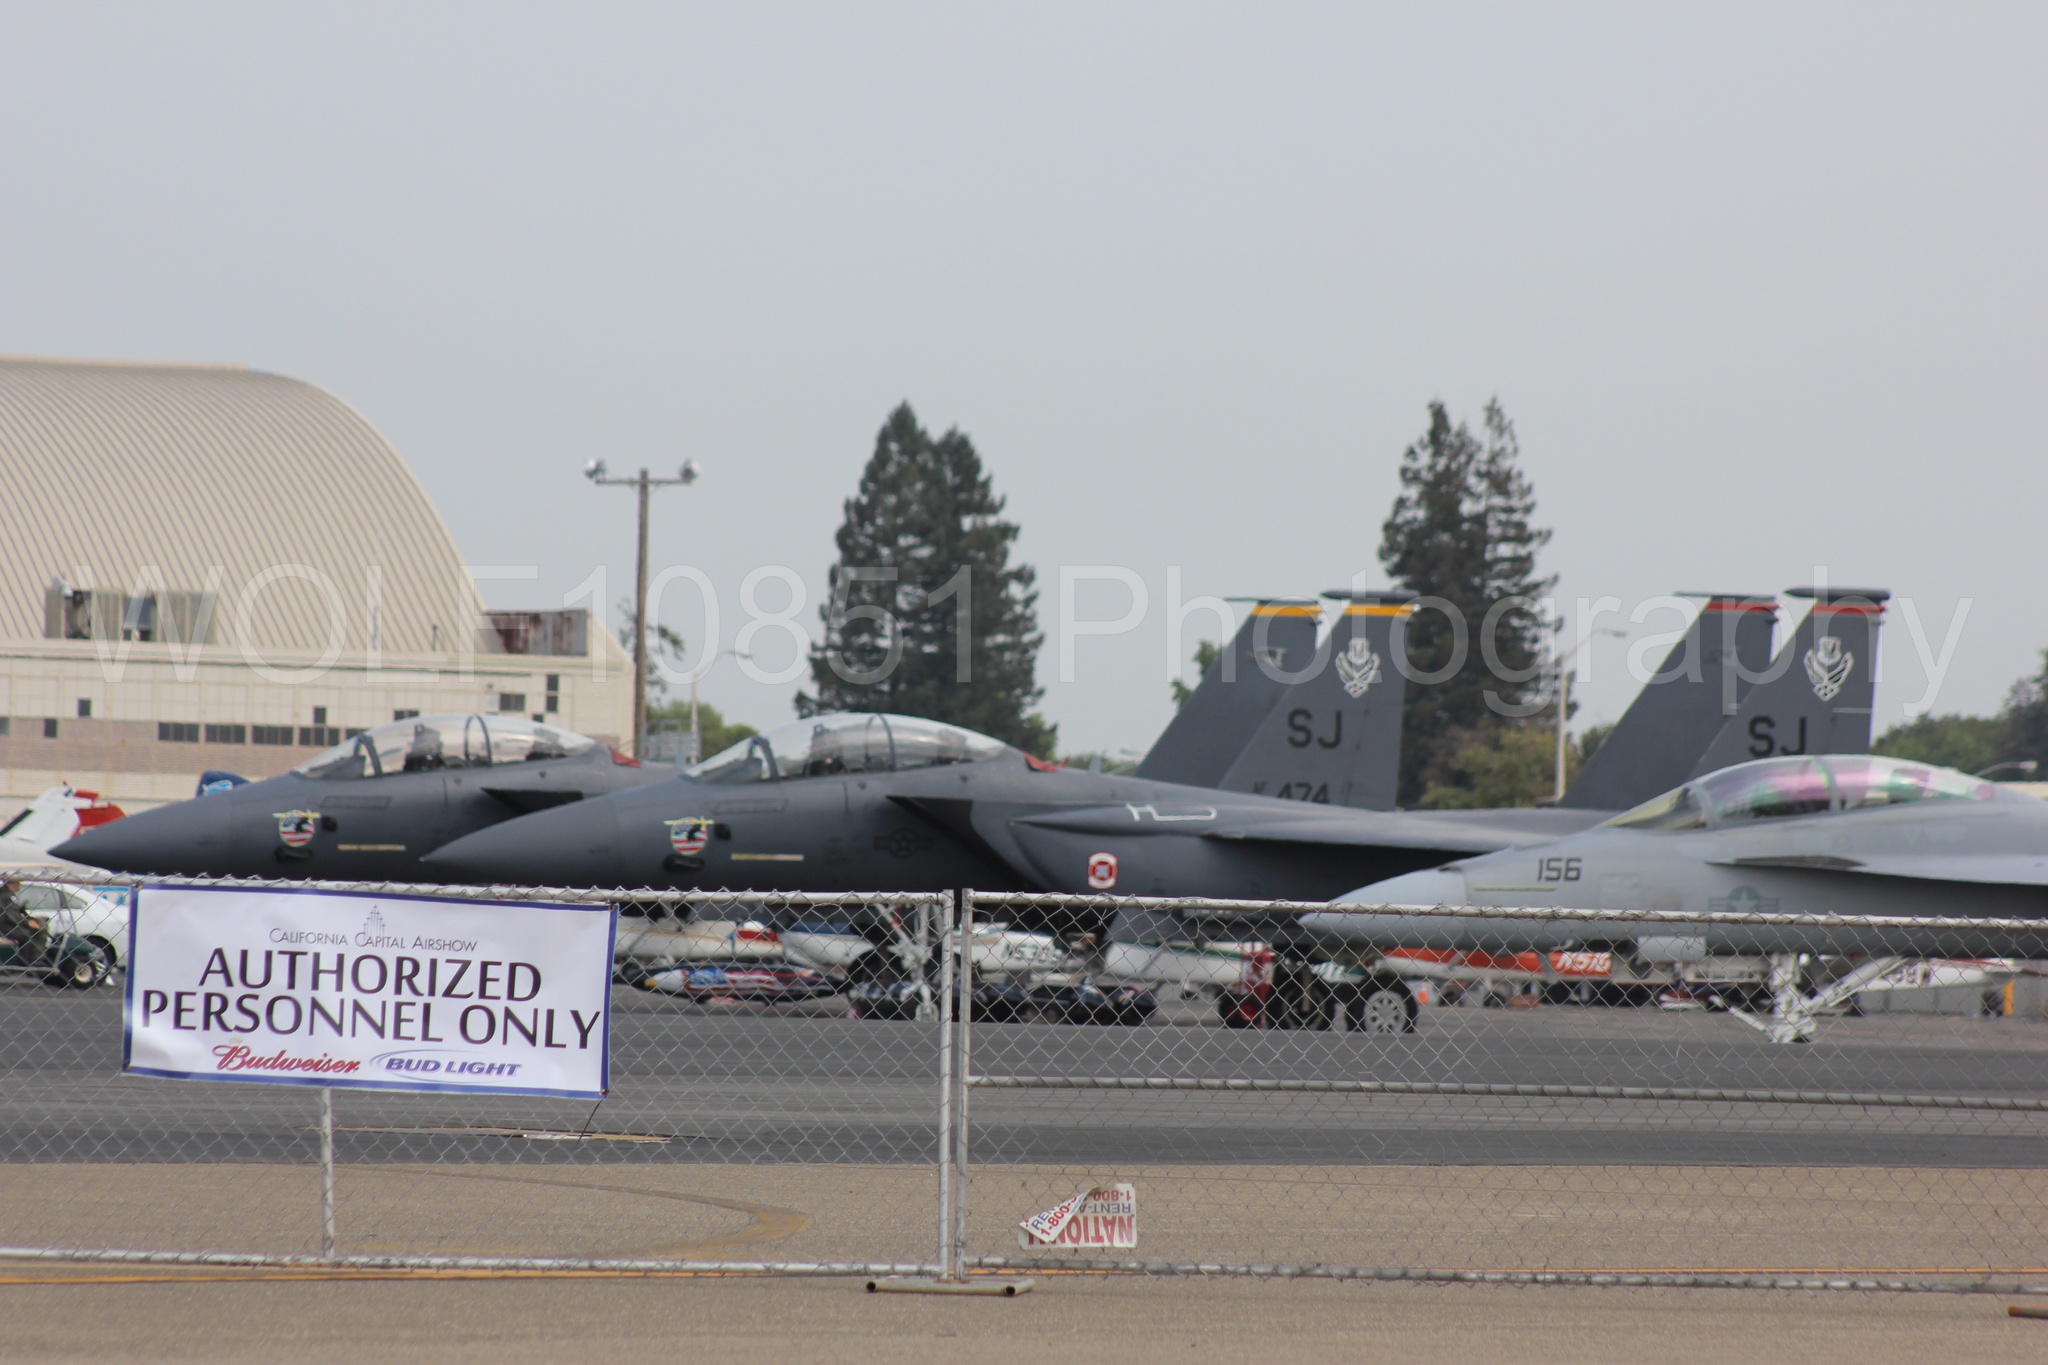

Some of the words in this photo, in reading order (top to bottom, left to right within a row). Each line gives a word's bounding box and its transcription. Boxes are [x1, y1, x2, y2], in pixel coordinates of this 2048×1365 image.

[1287, 708, 1342, 749] SJ
[1748, 715, 1807, 757] SJ
[1277, 782, 1330, 804] 474
[1537, 857, 1583, 882] 156
[199, 947, 541, 1002] AUTHORIZED
[142, 989, 443, 1042] PERSONNEL
[459, 1004, 601, 1049] ONLY
[212, 1045, 361, 1074] Budweiser
[385, 1058, 440, 1072] BUD
[444, 1061, 522, 1077] LIGHT
[1028, 1215, 1134, 1245] NATIO
